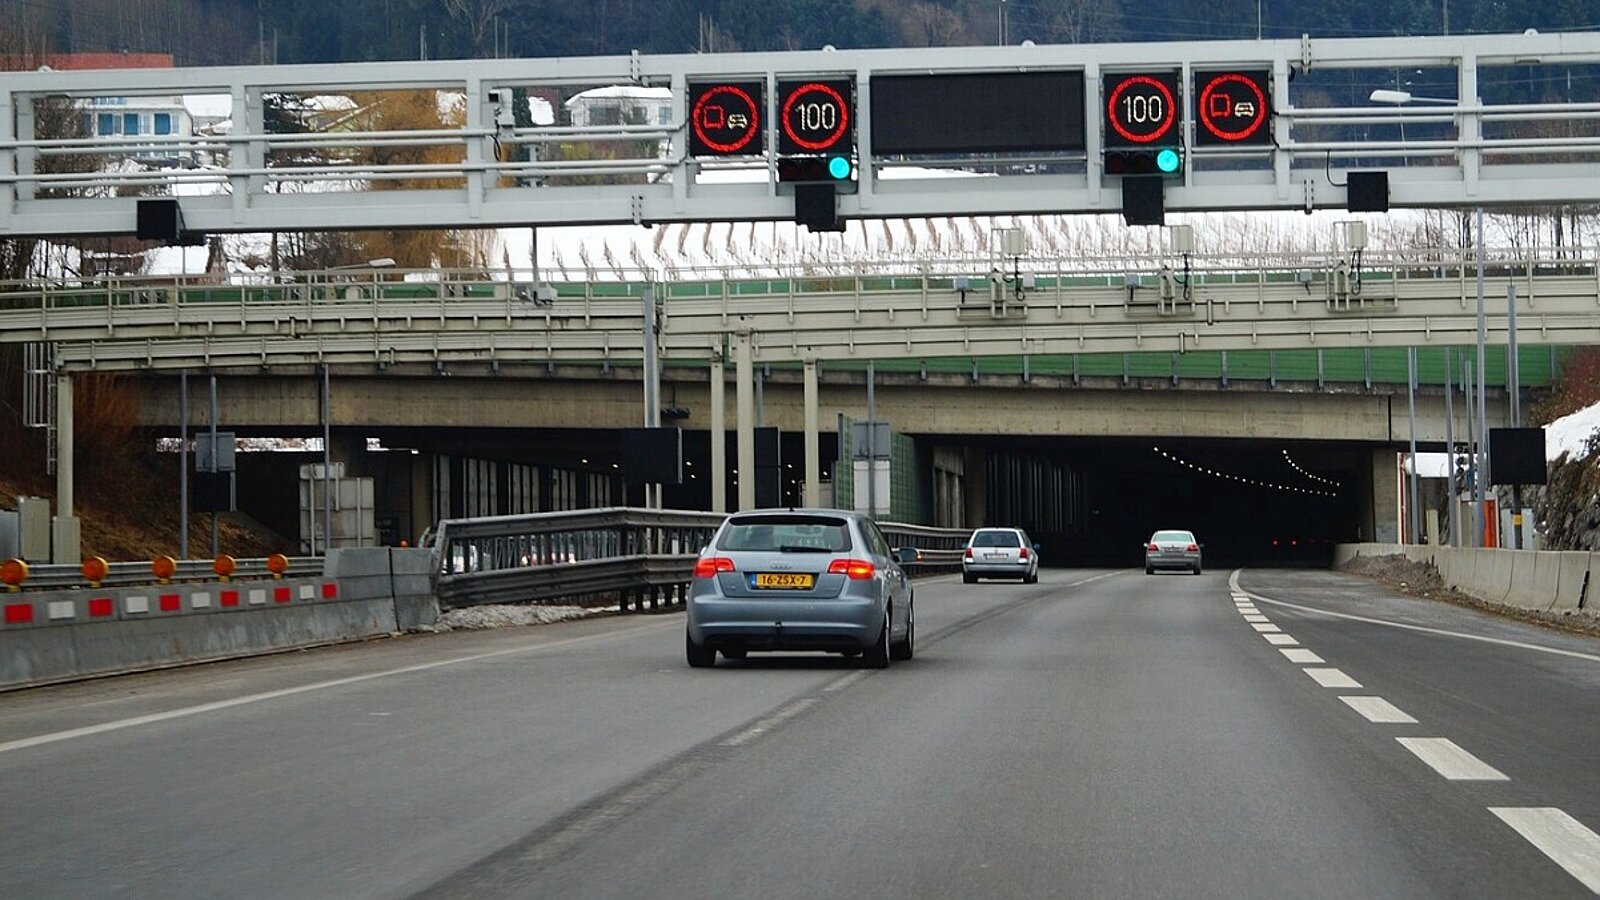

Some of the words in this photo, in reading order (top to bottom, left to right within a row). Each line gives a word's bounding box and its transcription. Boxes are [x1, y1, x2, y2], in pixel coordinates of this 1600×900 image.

[795, 102, 835, 130] 100
[1122, 95, 1162, 123] 100
[761, 574, 806, 585] 16-ZSX-7
